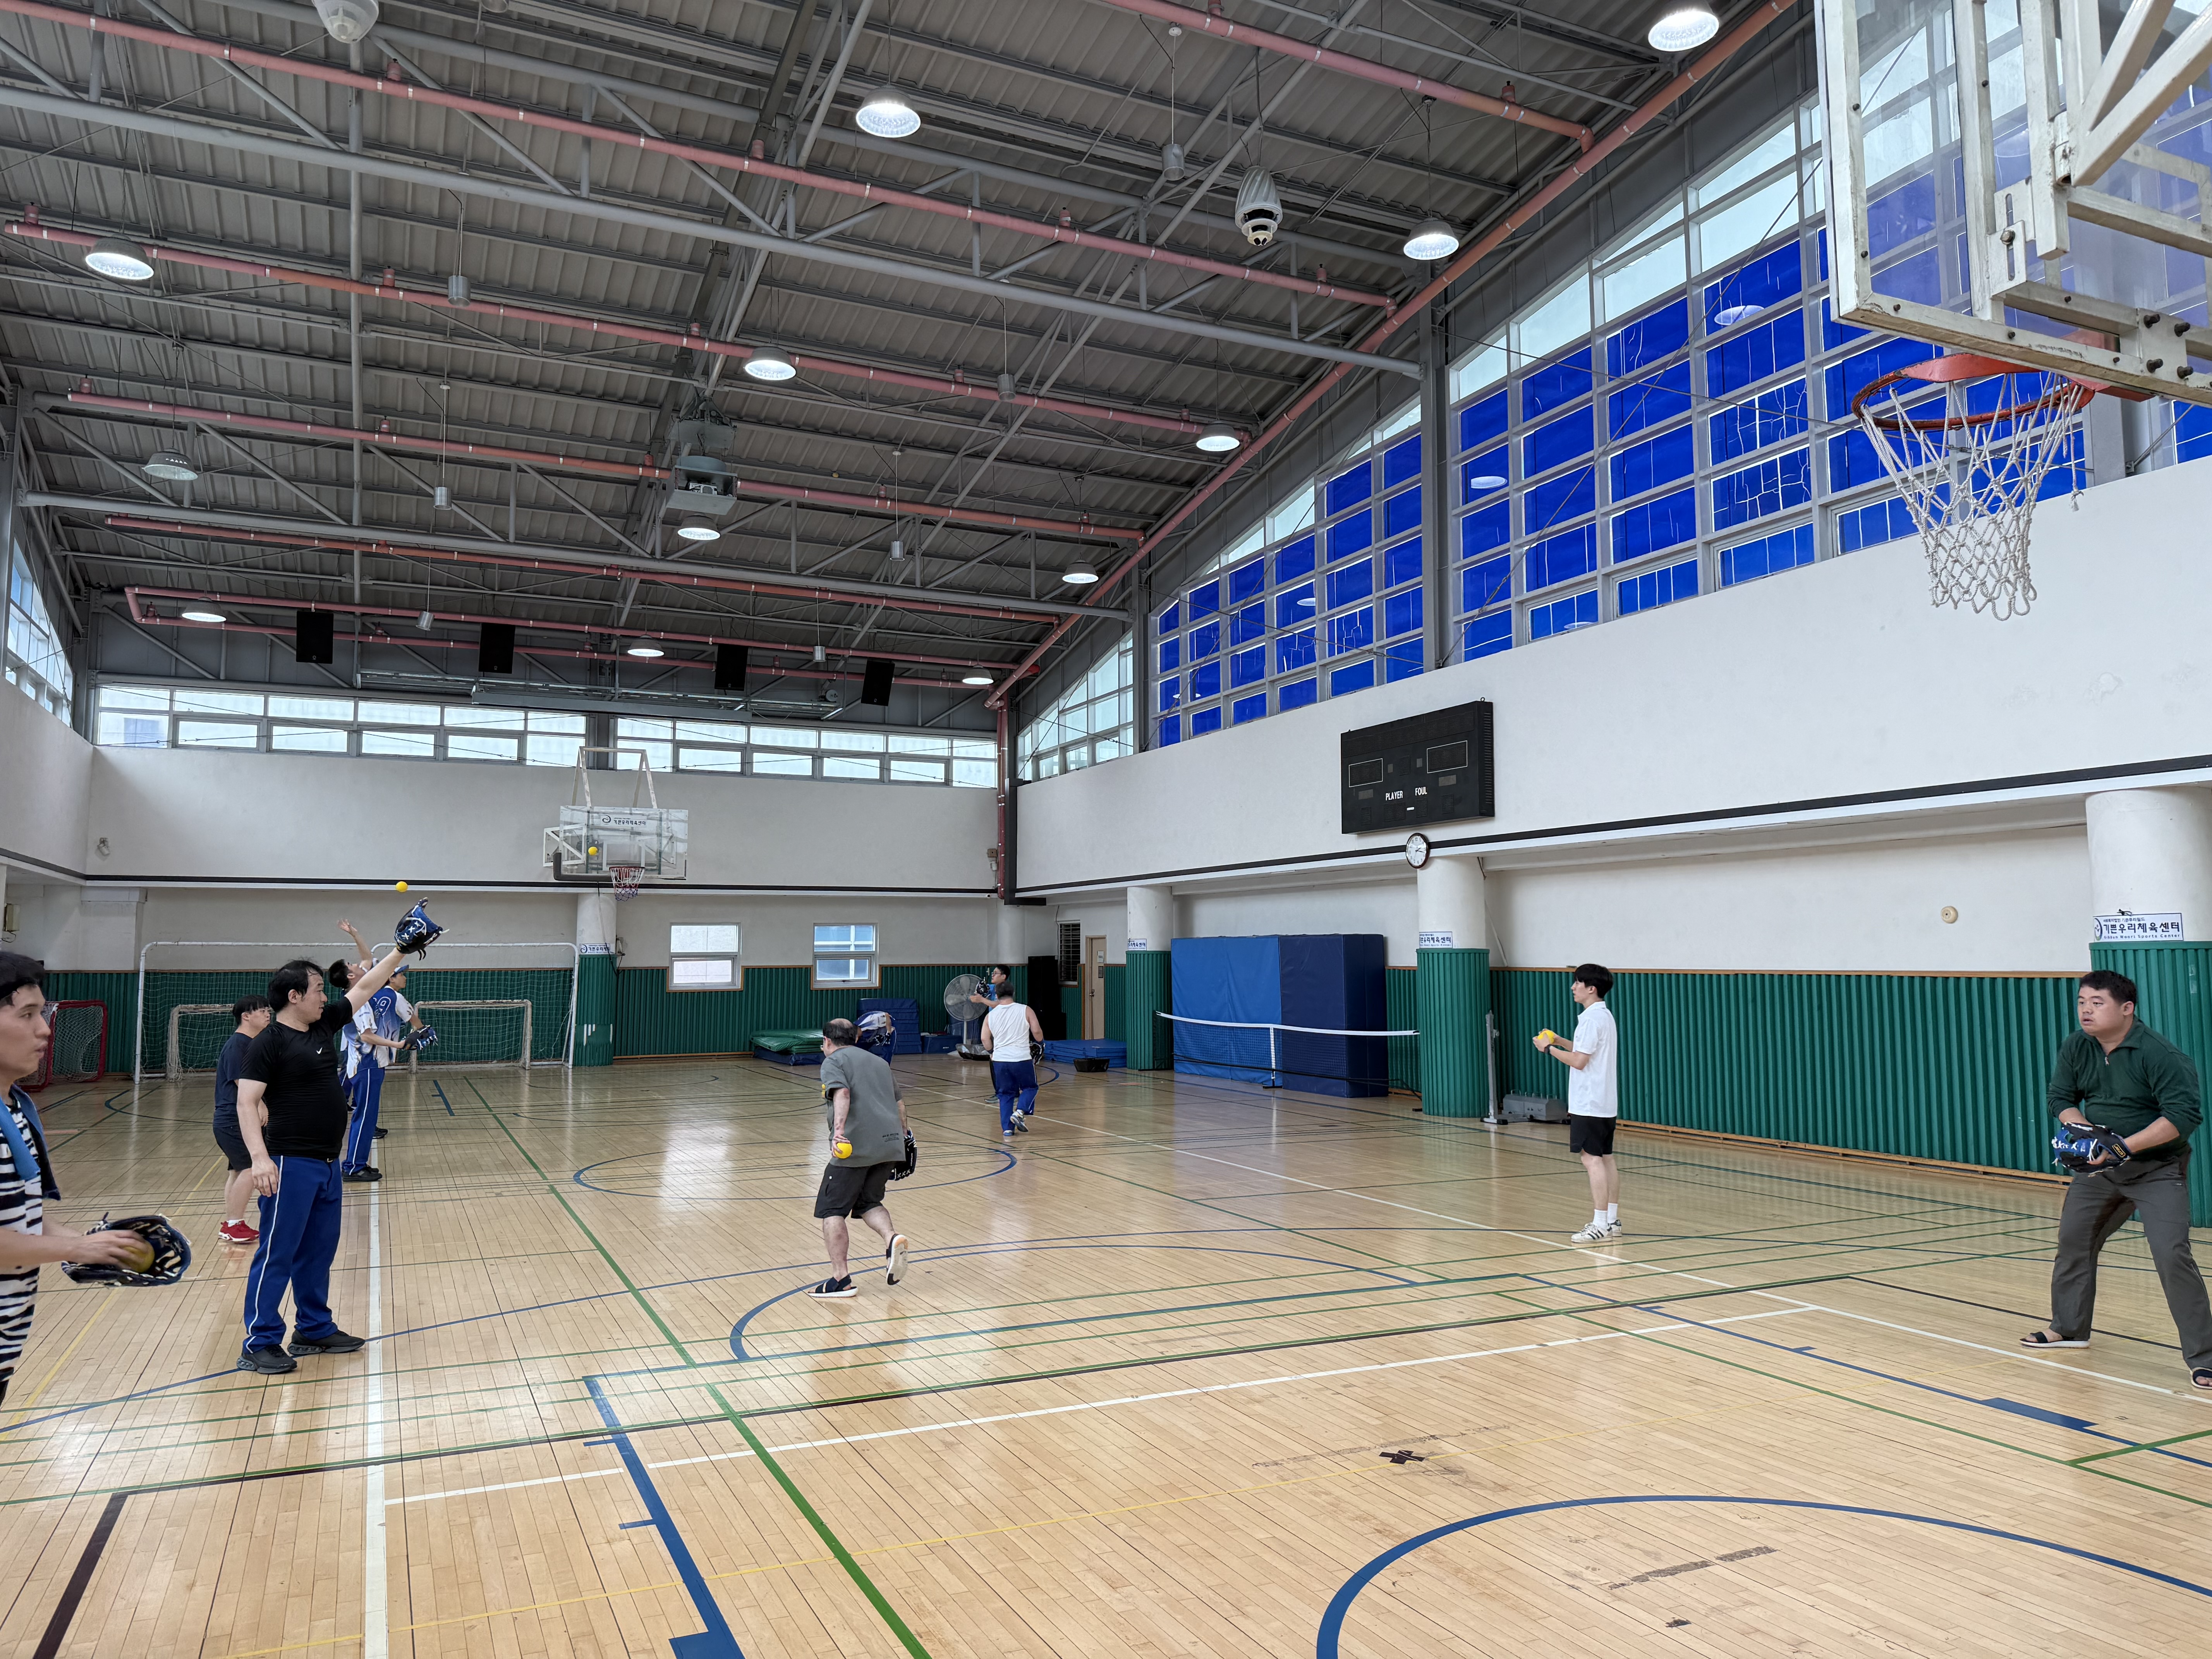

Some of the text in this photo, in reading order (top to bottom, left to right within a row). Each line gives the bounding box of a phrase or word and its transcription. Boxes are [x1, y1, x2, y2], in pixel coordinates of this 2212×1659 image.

[1386, 787, 1427, 801] PLAYER FOUL
[2103, 922, 2180, 934] 기쁜우리체육센터
